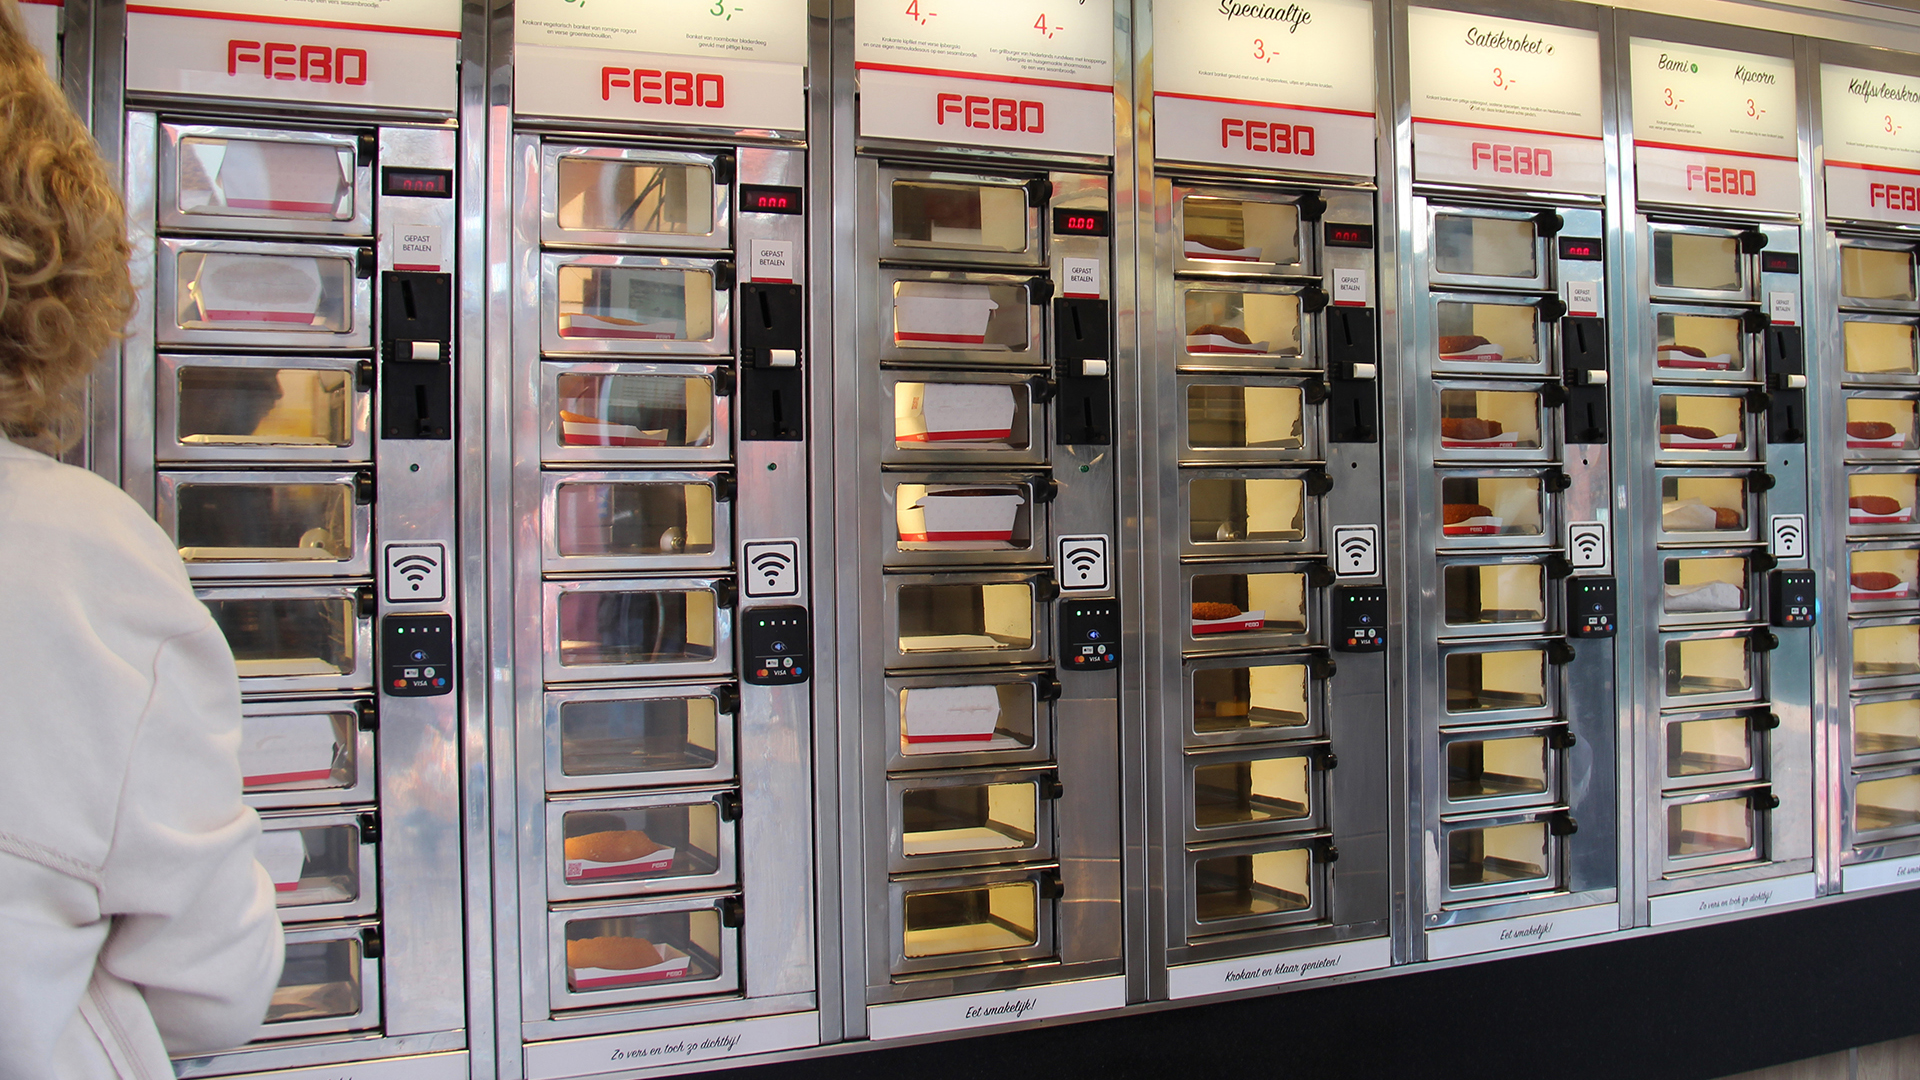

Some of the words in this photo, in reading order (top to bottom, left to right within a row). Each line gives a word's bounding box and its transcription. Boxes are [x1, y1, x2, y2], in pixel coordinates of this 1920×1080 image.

[905, 0, 937, 25] 4,-
[1218, 0, 1312, 34] Speciaaltje
[1034, 13, 1064, 39] 4,-
[1253, 38, 1280, 63] 3,-
[1464, 27, 1543, 55] Satékroket
[228, 39, 367, 86] FEBO
[1657, 53, 1688, 73] Bami
[1734, 65, 1776, 85] Kipcorn
[602, 66, 724, 108] FEBO
[1493, 67, 1516, 91] 3,-
[1664, 87, 1685, 110] 3,-
[1746, 99, 1766, 120] 3,-
[937, 92, 1044, 134] FEBO
[1884, 115, 1902, 136] 3,-
[1222, 118, 1315, 156] FEBO
[1472, 142, 1552, 177] FEBO
[1687, 165, 1756, 196] FEBO
[1870, 183, 1920, 211] FEB
[403, 244, 432, 252] BETALEN
[1500, 929, 1513, 941] Eet
[1513, 922, 1553, 940] smakelijk!
[665, 970, 683, 978] FEBO
[1224, 968, 1260, 982] Krokant
[1262, 969, 1273, 977] en
[1274, 963, 1300, 975] klaar
[1300, 954, 1342, 976] genieten!
[965, 1005, 982, 1018] Eet
[983, 998, 1037, 1018] smakelijk!
[611, 1049, 623, 1061] Zo
[626, 1048, 648, 1059] vers
[650, 1047, 662, 1056] en
[663, 1041, 684, 1055] toch
[687, 1043, 698, 1057] zo
[700, 1034, 742, 1052] dichtbij!
